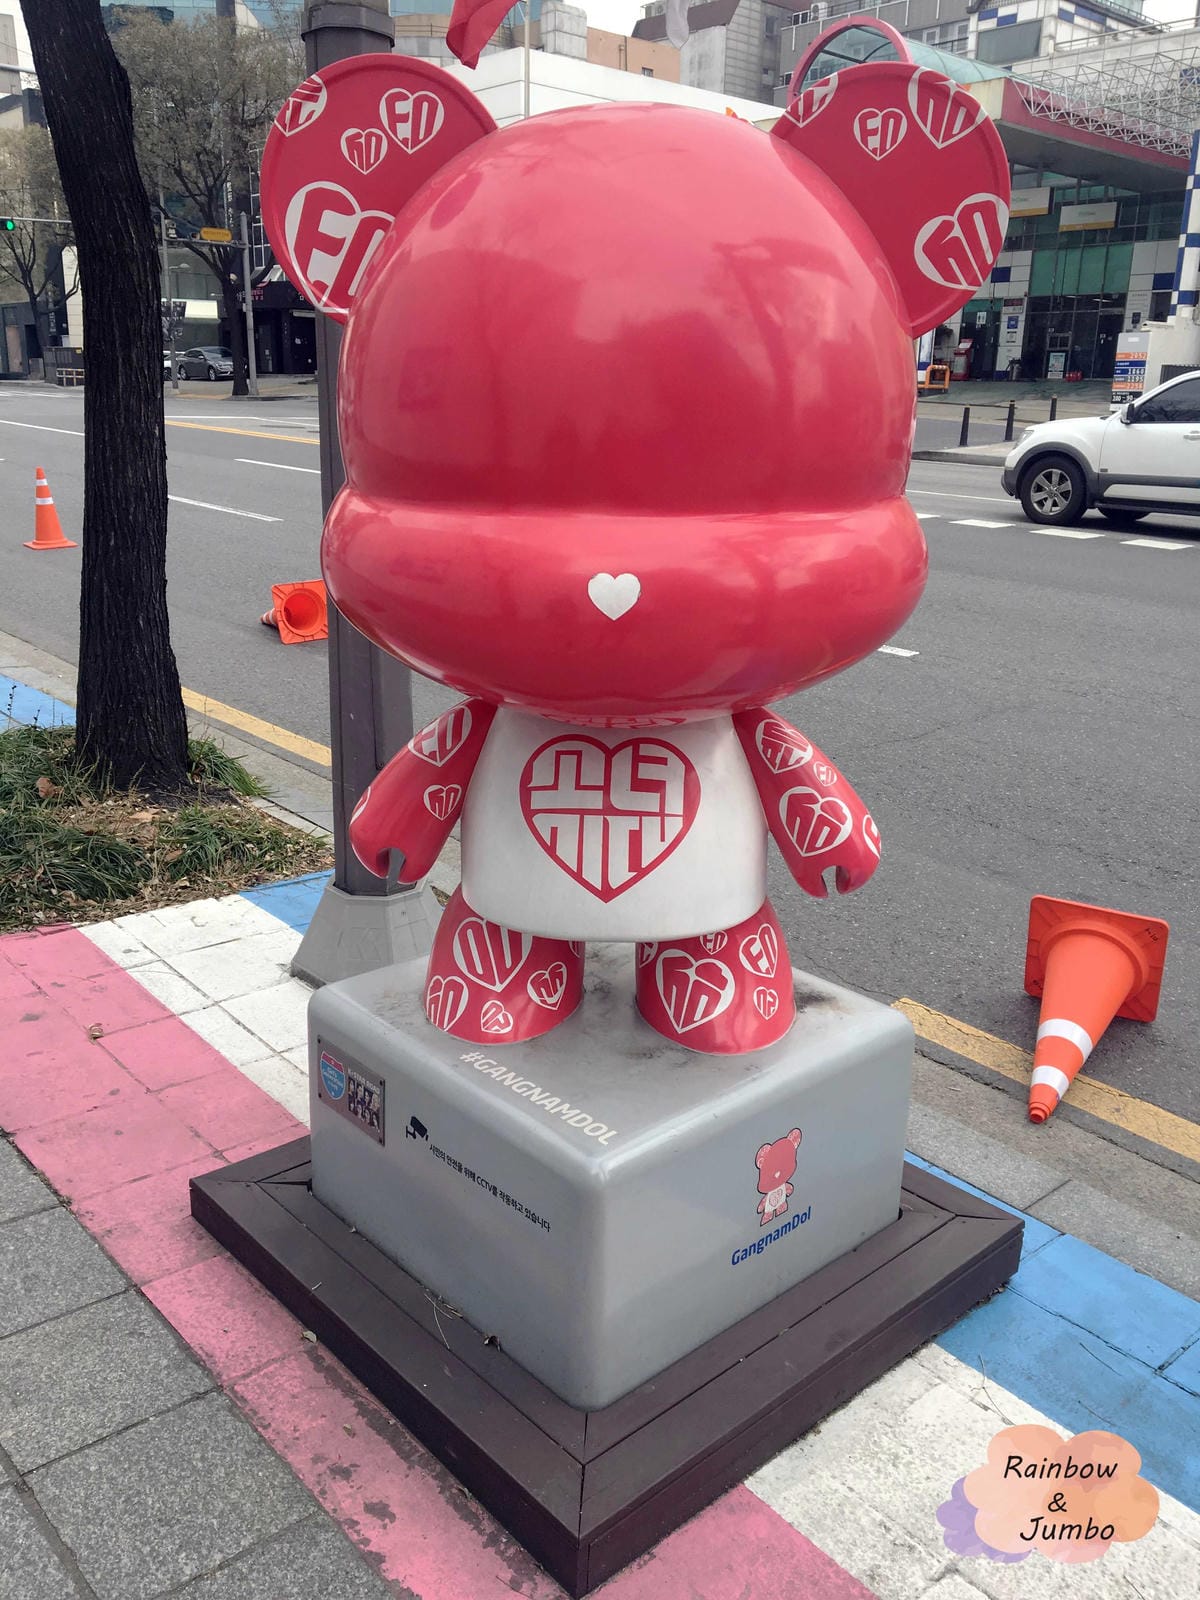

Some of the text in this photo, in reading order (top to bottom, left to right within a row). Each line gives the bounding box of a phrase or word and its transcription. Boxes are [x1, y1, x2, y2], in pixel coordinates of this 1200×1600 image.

[459, 1052, 619, 1146] #GANGNAMDOL
[429, 1144, 551, 1232] 시민의 안전을 위해 CCTV를 작동하고 있습니다
[731, 1206, 812, 1266] GangnamDol
